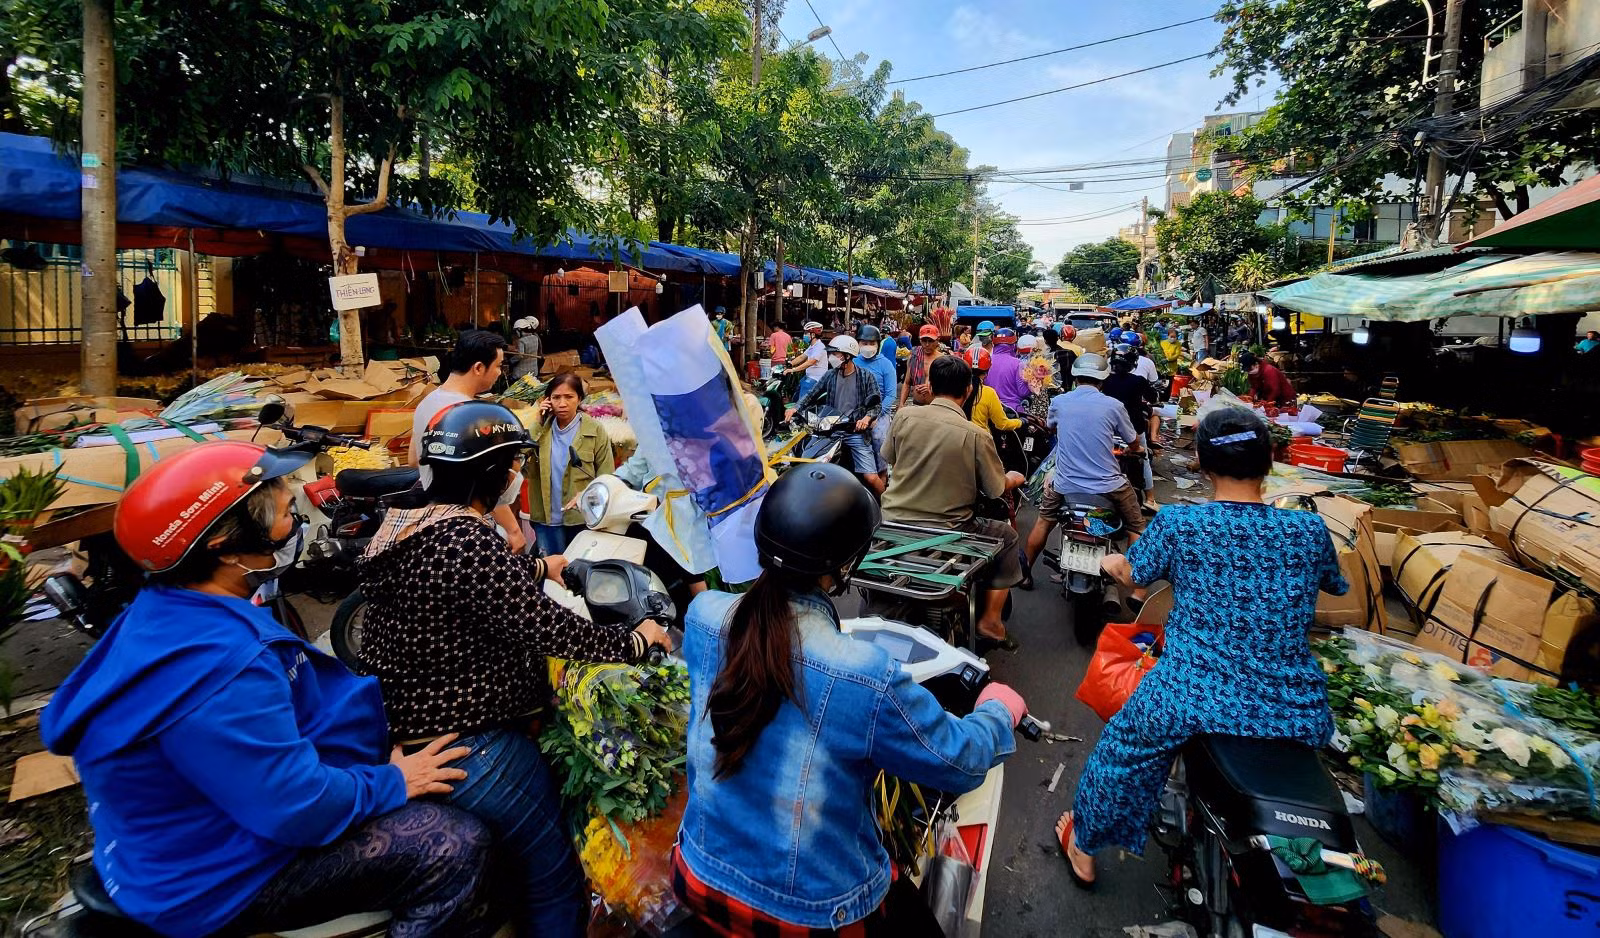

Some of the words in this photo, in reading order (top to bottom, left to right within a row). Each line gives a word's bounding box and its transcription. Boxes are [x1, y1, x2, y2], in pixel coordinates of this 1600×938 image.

[475, 429, 480, 437] I
[492, 423, 506, 434] MY
[152, 519, 183, 546] Honda
[198, 481, 226, 502] Minh
[1274, 810, 1331, 830] HONDA
